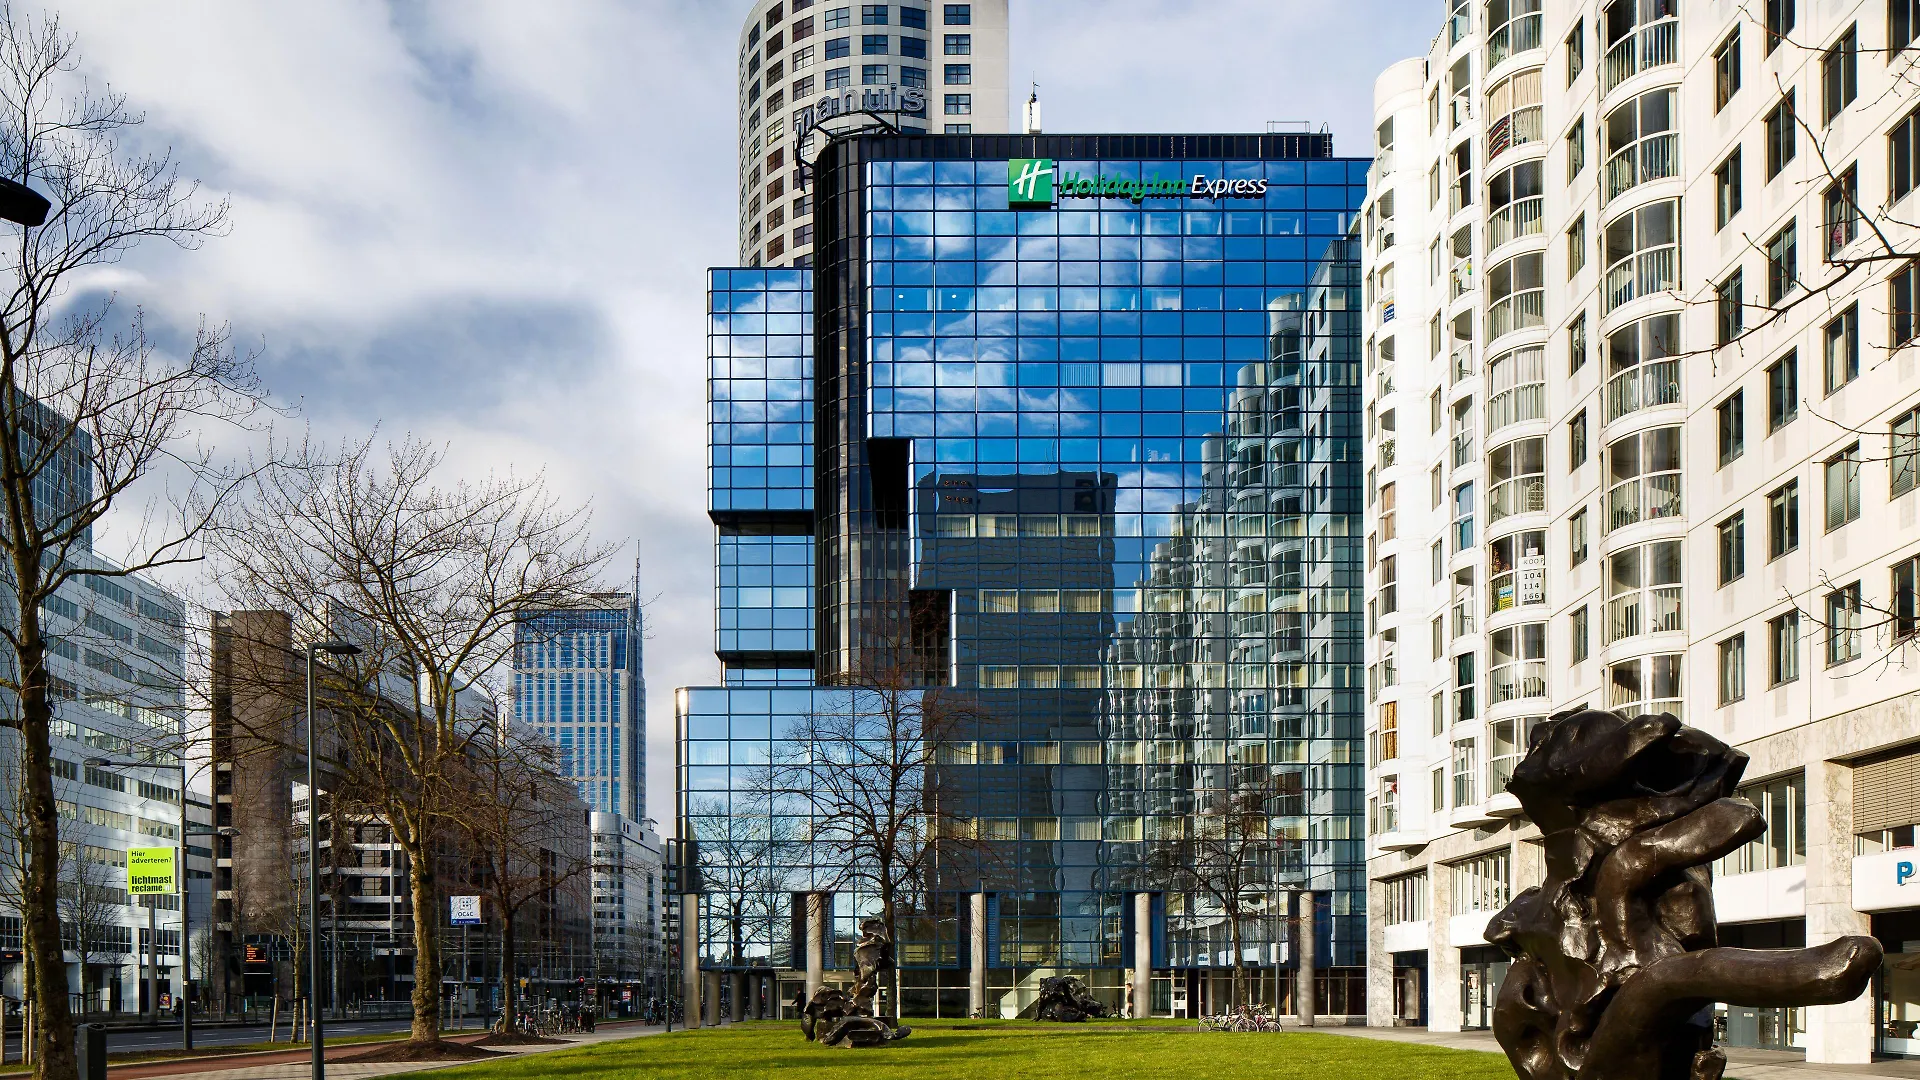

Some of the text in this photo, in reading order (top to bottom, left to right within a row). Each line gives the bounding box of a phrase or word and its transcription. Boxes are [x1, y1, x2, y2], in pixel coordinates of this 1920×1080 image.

[1059, 171, 1268, 199] Holiday Inn Express
[1524, 572, 1541, 580] 104
[1524, 582, 1540, 590] 114
[131, 875, 172, 884] lichtmast
